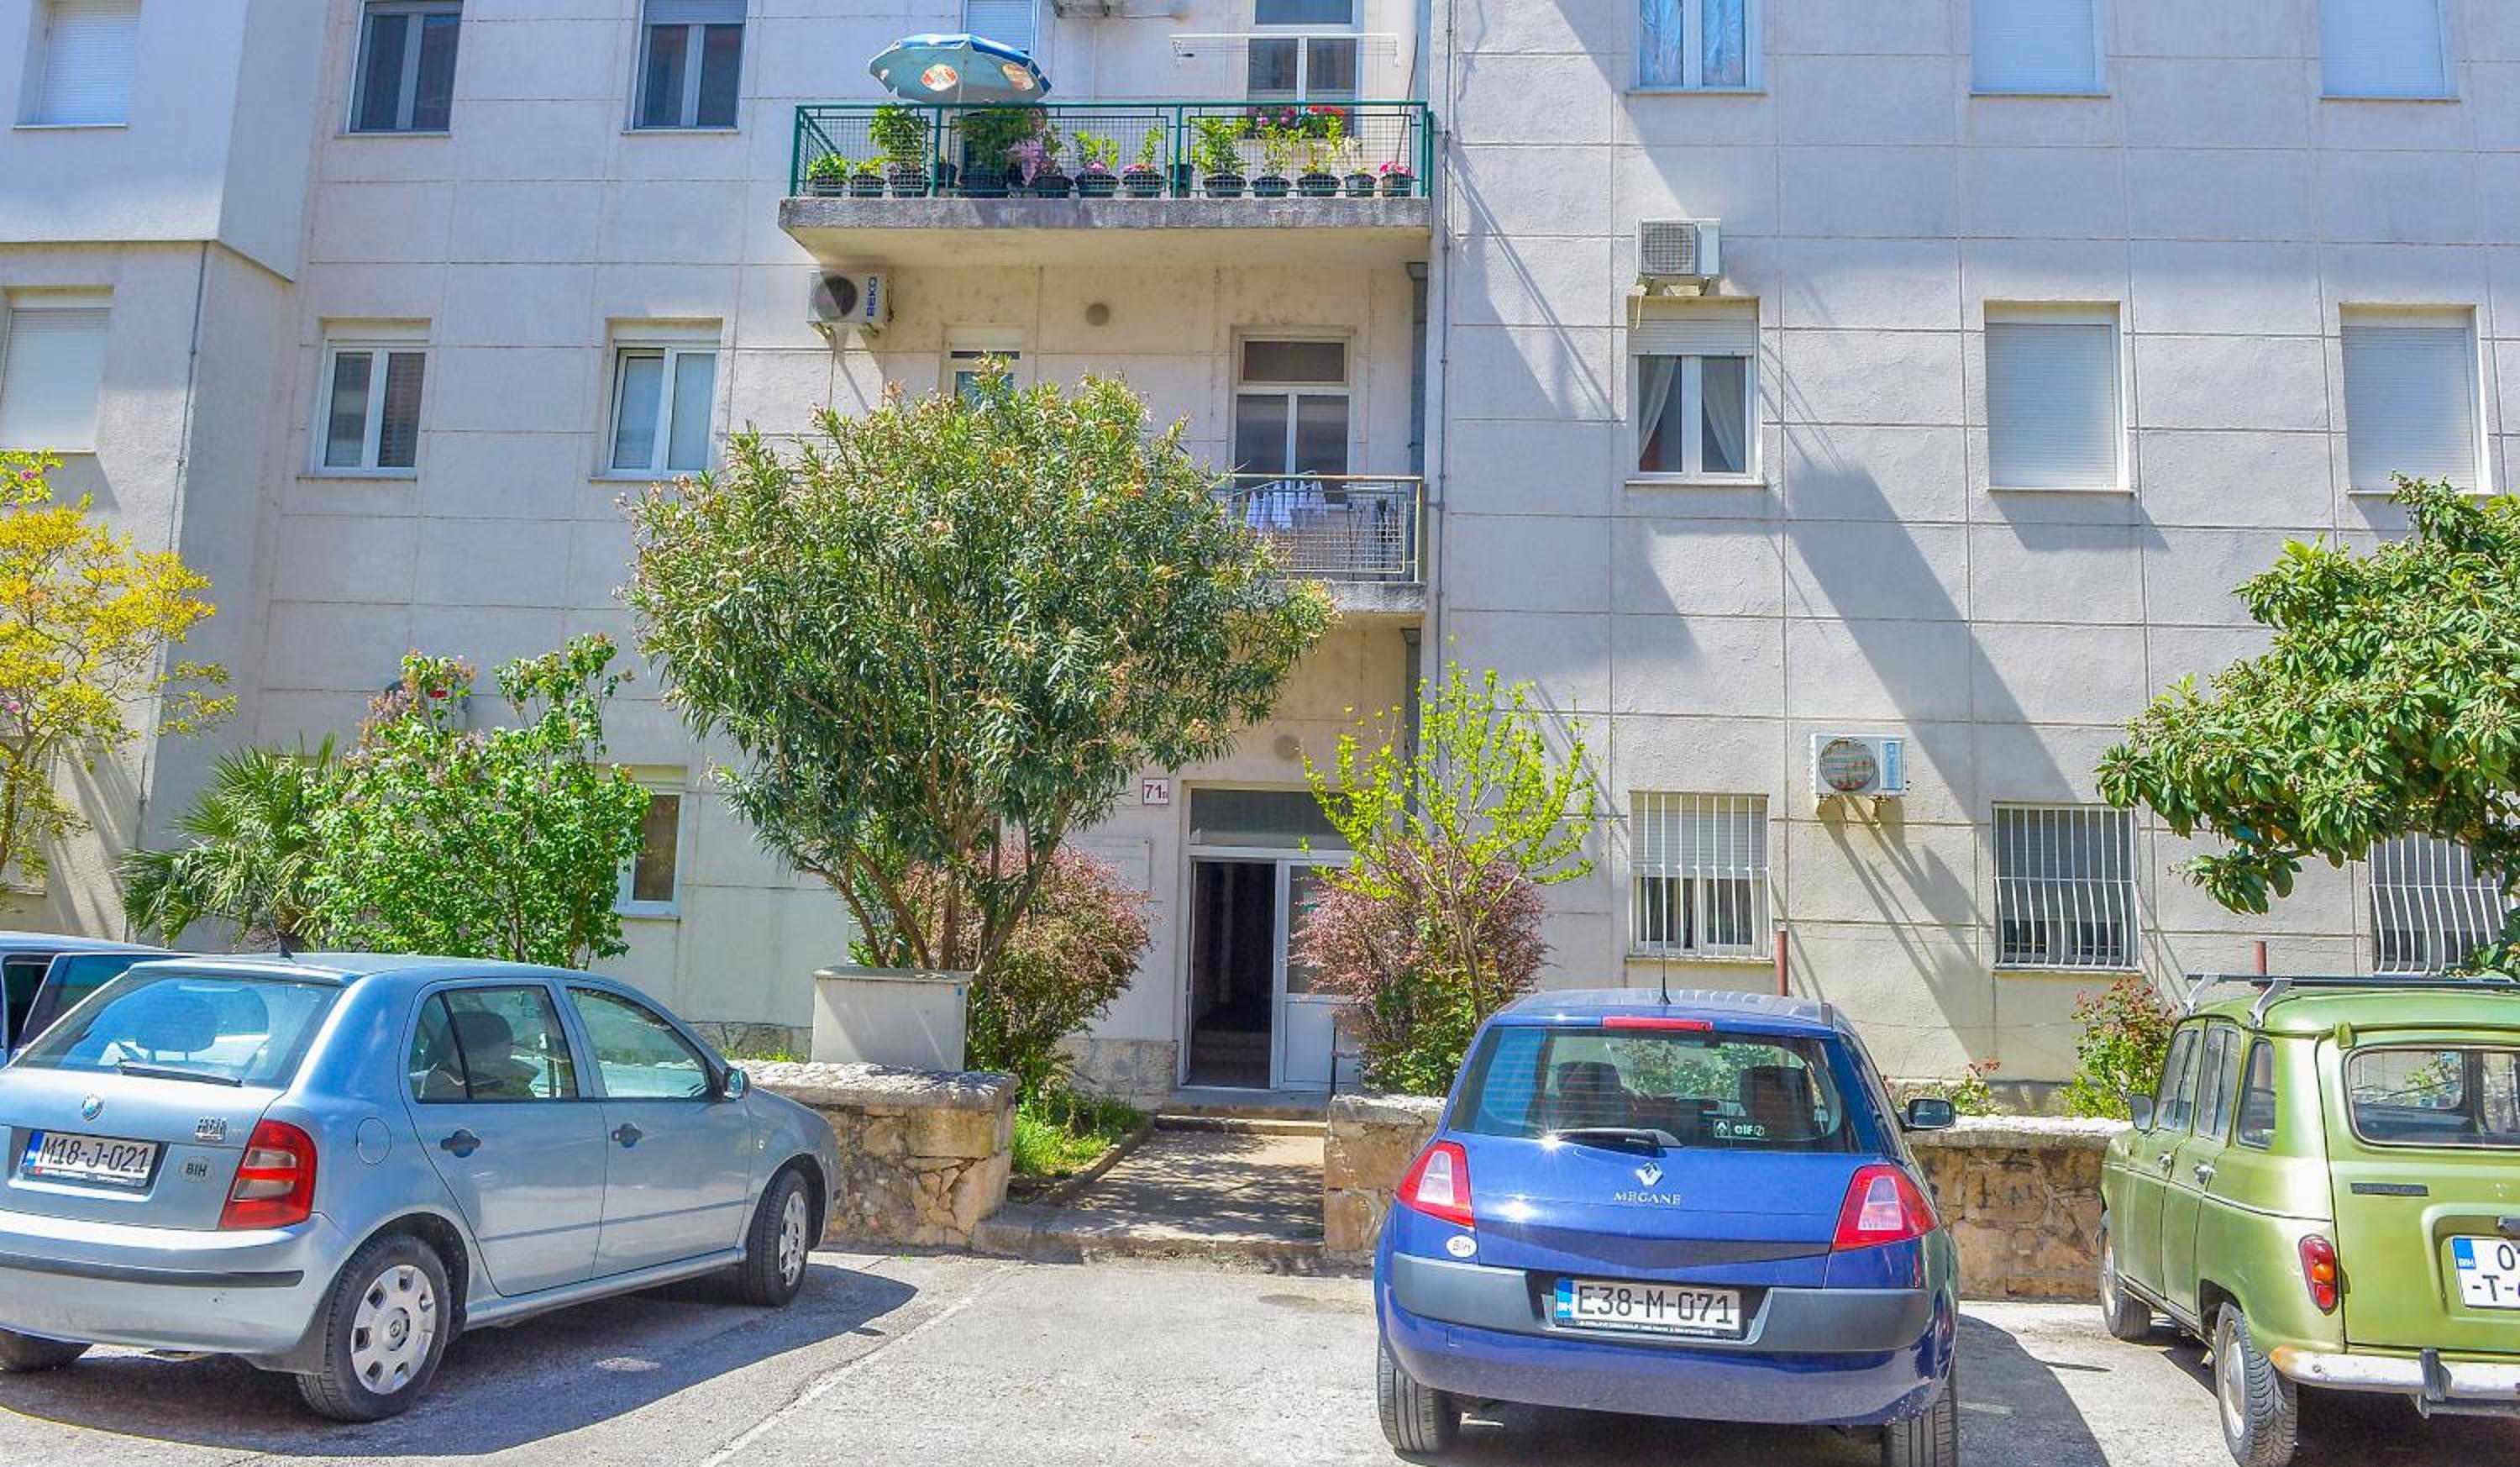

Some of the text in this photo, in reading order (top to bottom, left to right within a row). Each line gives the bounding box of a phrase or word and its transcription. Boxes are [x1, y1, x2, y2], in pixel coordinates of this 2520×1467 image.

[40, 1138, 150, 1174] M18-J-021
[186, 1163, 207, 1176] BIH
[1578, 1286, 1733, 1325] E38-M-071
